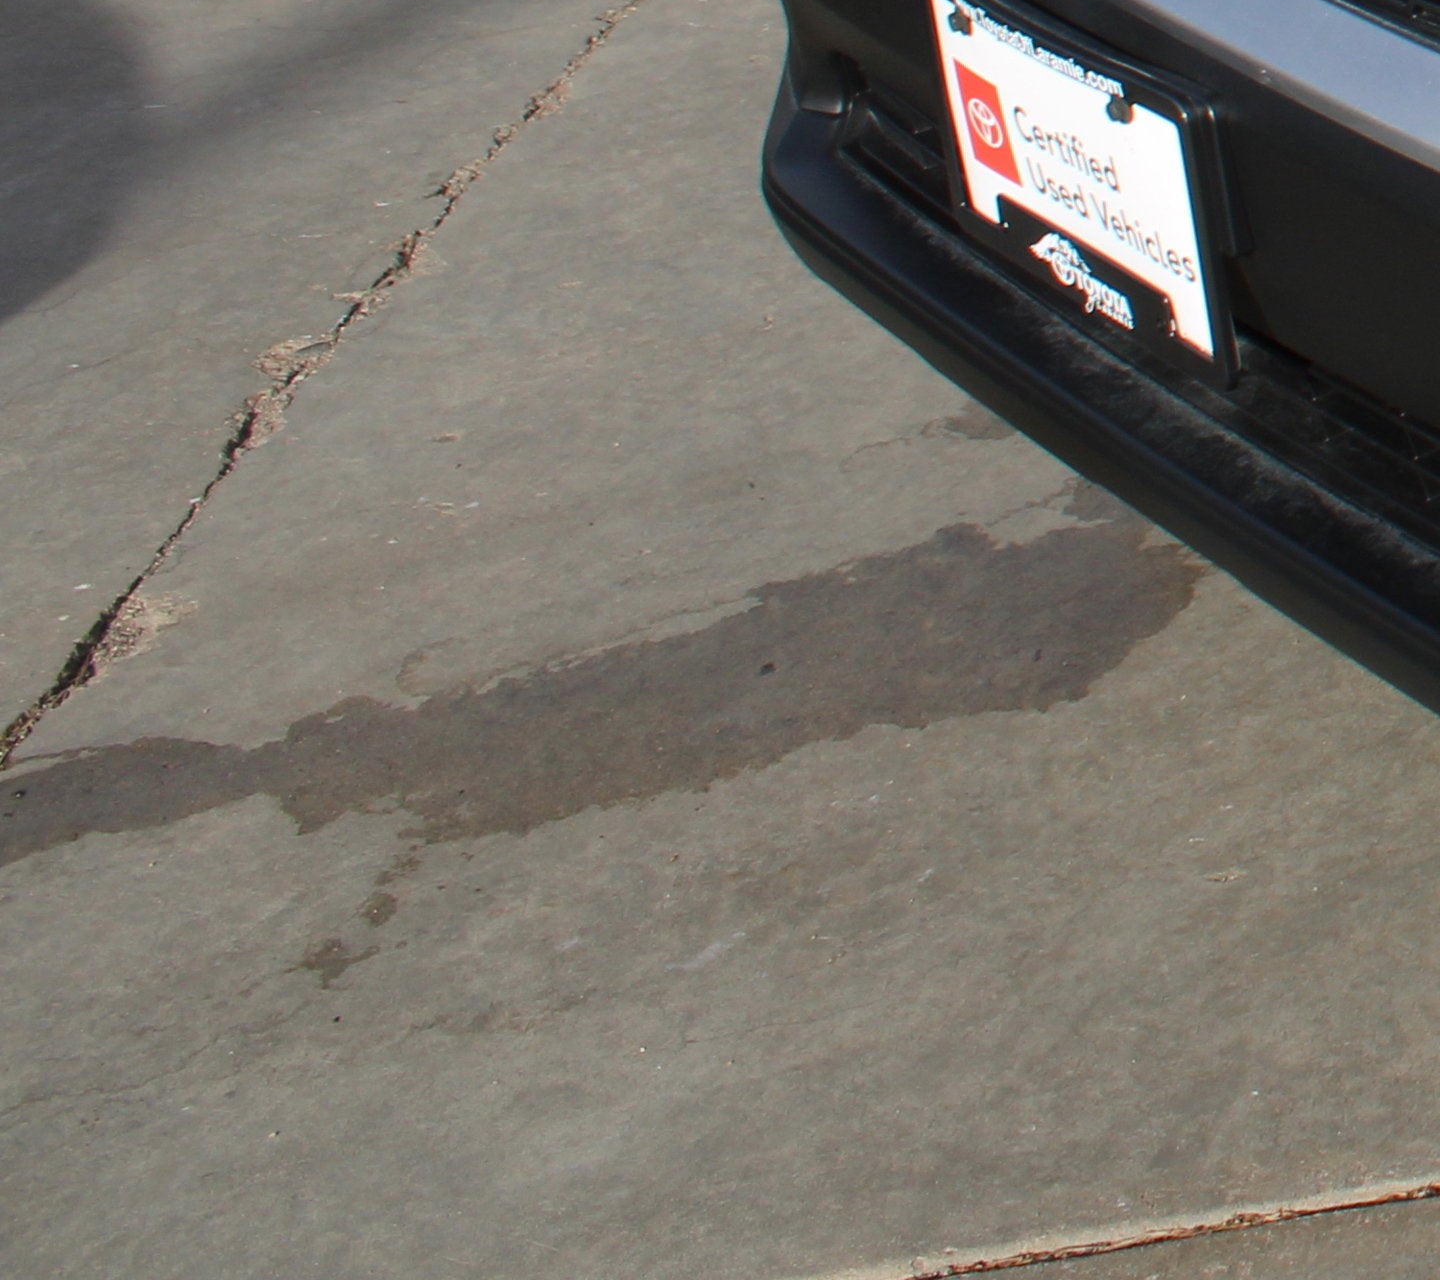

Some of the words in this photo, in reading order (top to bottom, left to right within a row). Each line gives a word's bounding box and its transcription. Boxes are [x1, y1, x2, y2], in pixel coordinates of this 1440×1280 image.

[1013, 105, 1120, 192] Certified
[1028, 159, 1088, 218] Used
[1091, 192, 1197, 283] Vehicles
